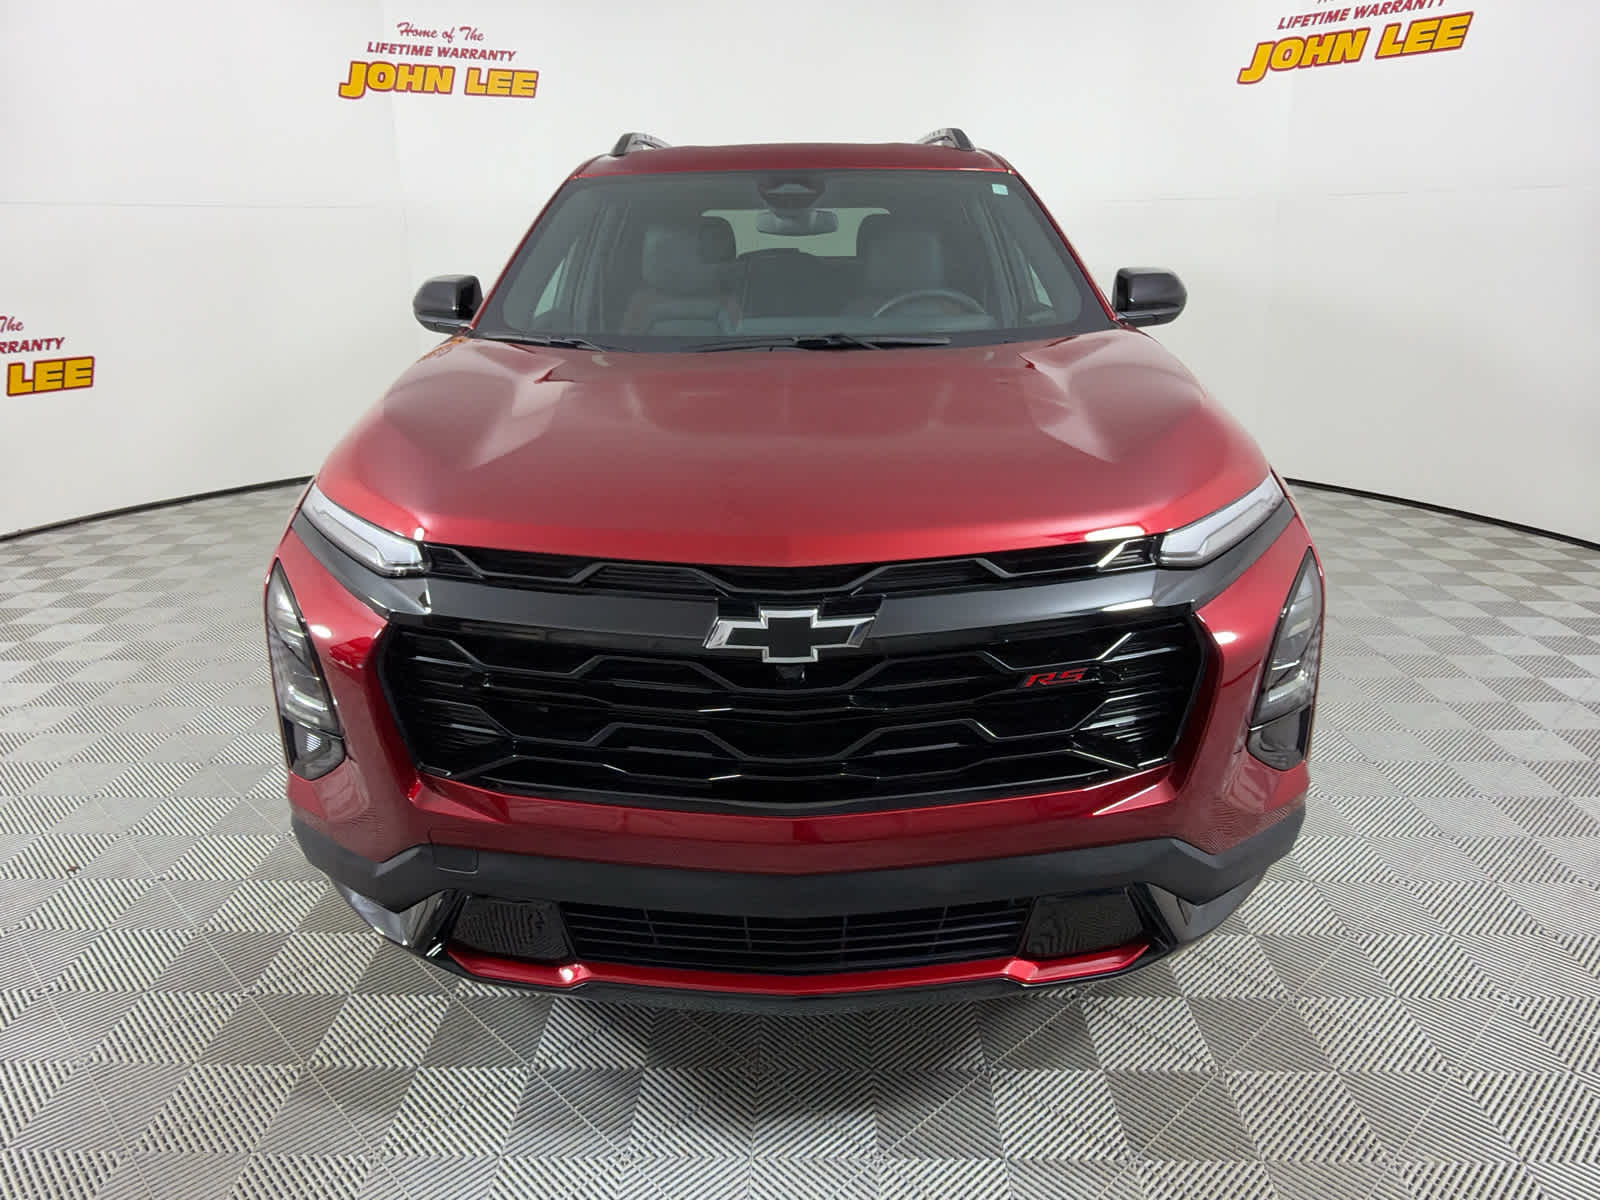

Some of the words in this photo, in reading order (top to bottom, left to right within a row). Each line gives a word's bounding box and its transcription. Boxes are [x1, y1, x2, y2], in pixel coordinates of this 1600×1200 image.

[1277, 8, 1350, 30] LIFETIME
[397, 21, 438, 39] Home
[441, 26, 455, 43] of
[459, 26, 485, 42] The
[366, 41, 434, 57] LIFETIME
[437, 46, 517, 62] WARRANTY
[1237, 27, 1371, 84] JOHN
[1375, 11, 1474, 59] LEE
[338, 60, 456, 100] JOHN
[464, 66, 540, 98] LEE
[6, 355, 95, 397] LEE
[1024, 667, 1088, 688] RS
